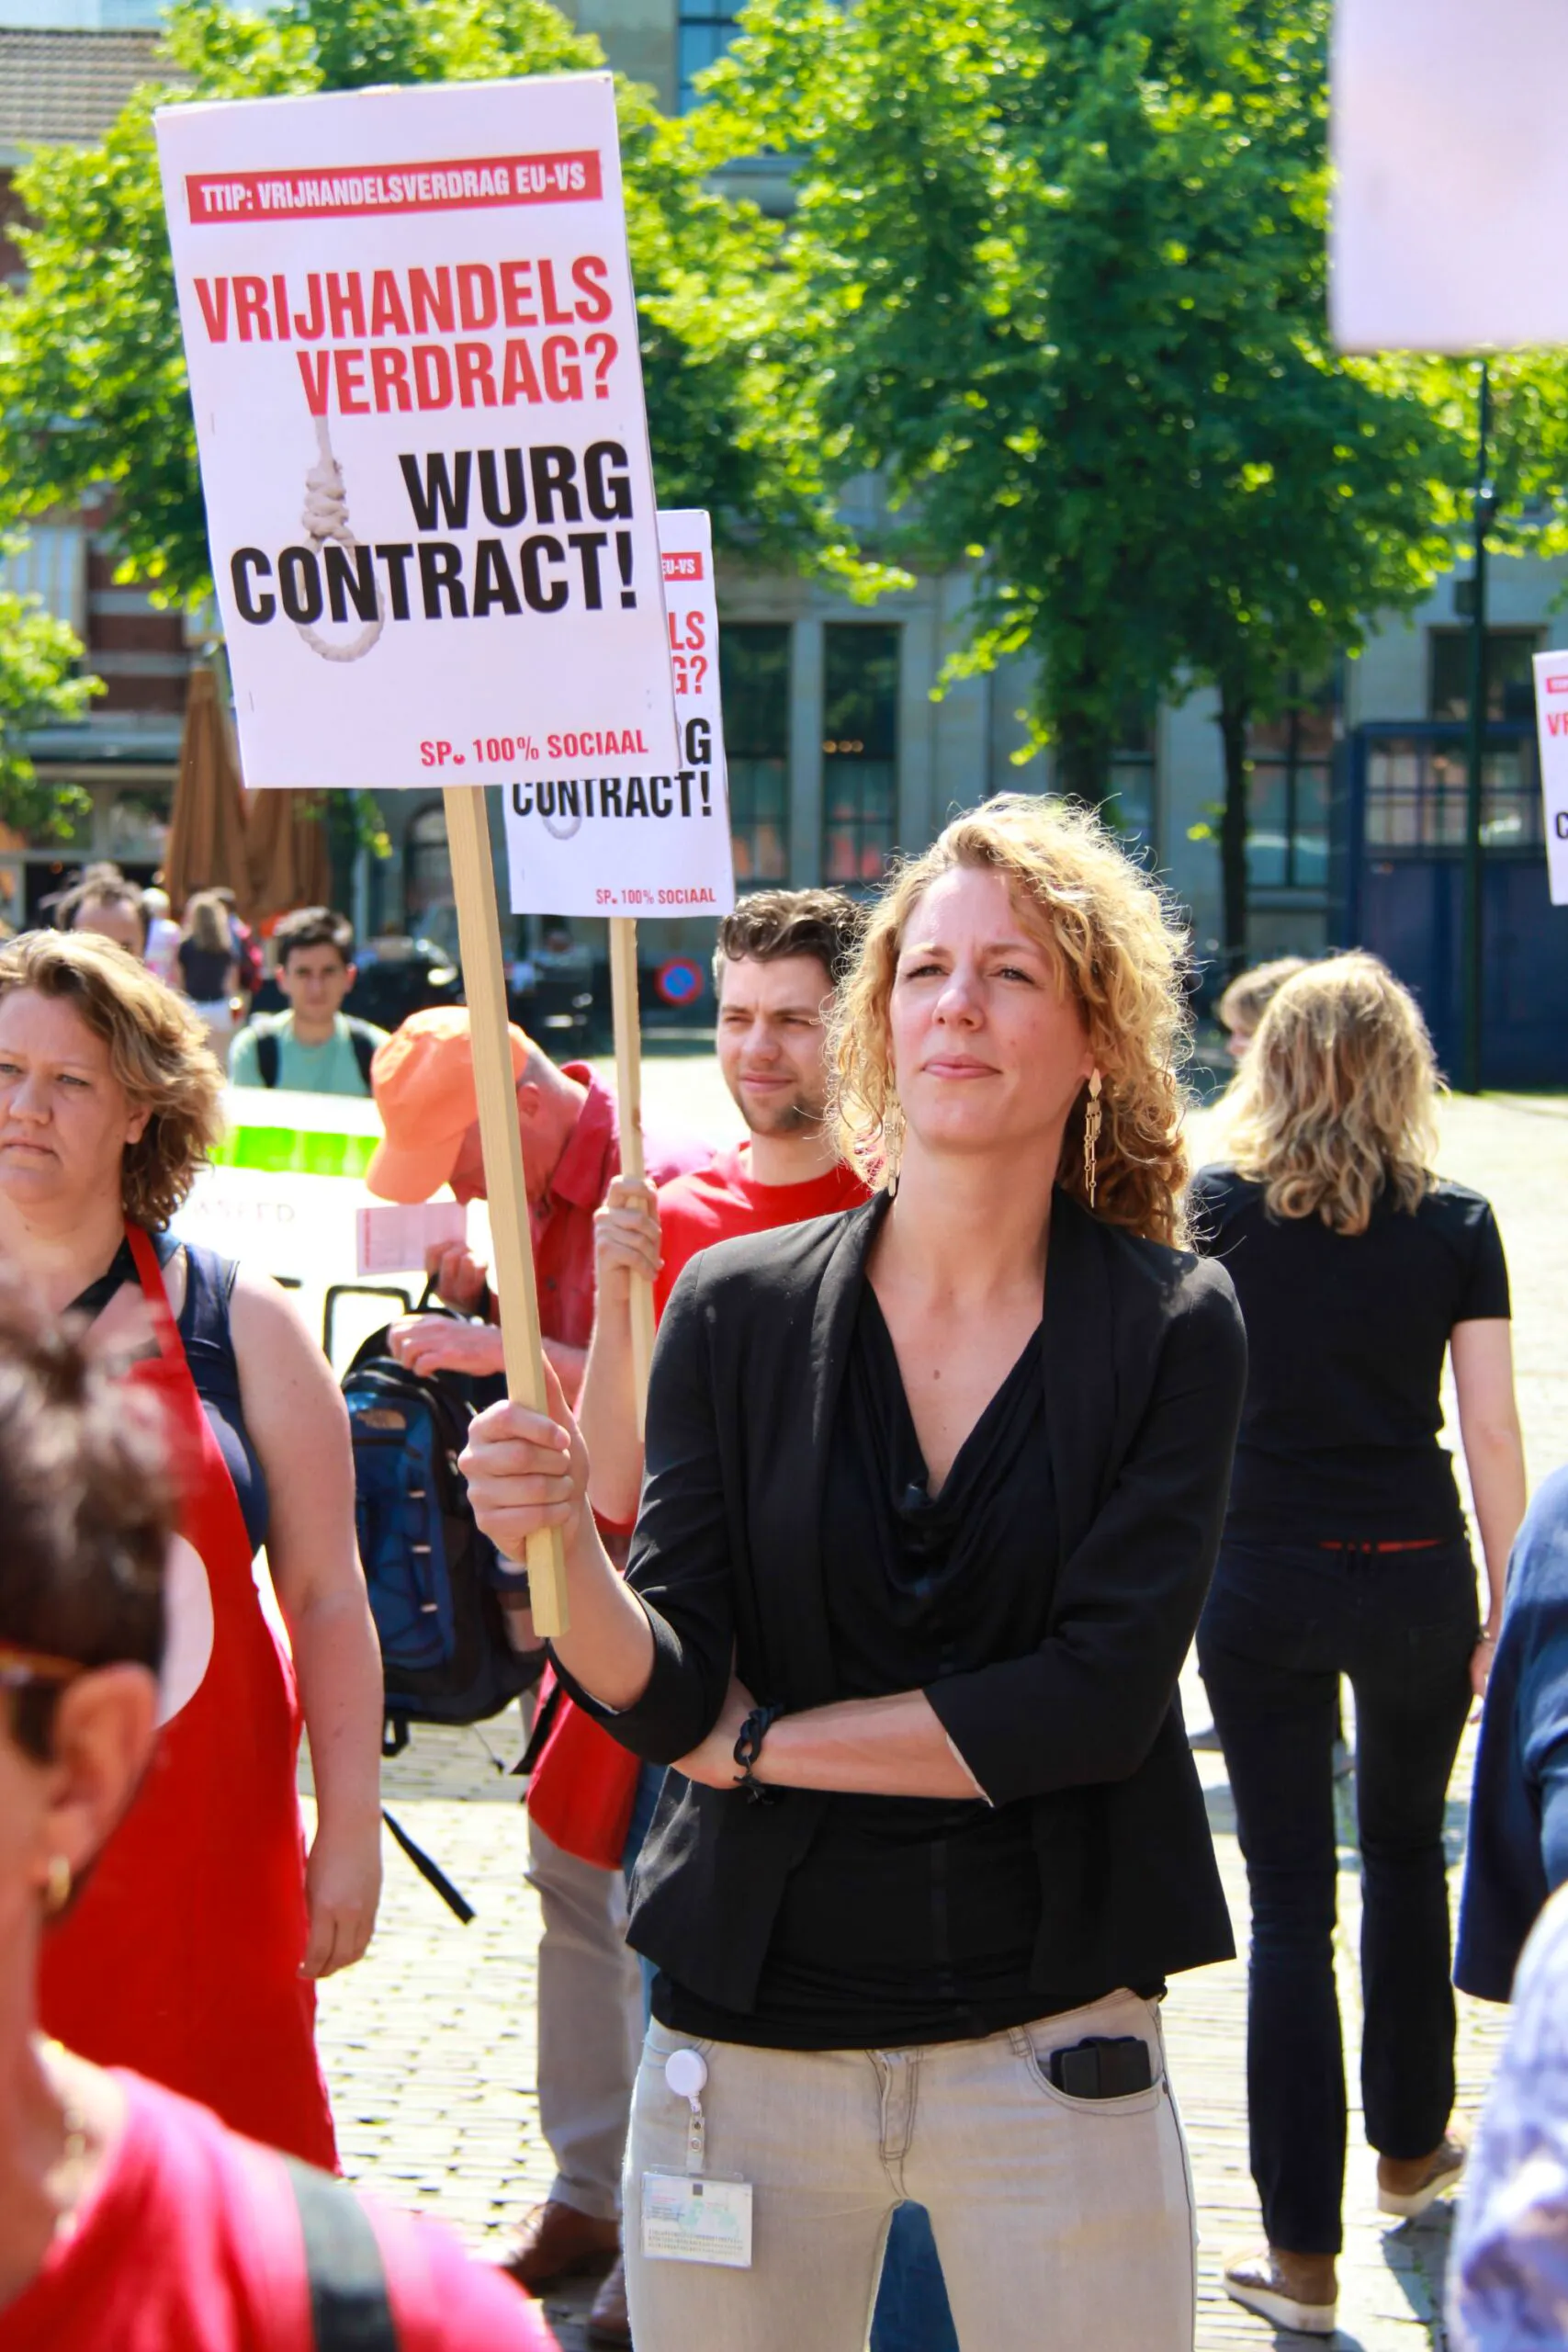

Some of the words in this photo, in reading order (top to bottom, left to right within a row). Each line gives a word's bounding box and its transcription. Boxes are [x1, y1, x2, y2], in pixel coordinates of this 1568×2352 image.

[199, 182, 254, 212] TTIP:
[257, 166, 511, 210] VRIJHANDELSVERDRAG
[515, 160, 587, 195] EU-VS
[194, 254, 613, 344] VRIJHANDELS
[296, 331, 618, 416] VERDRAG?
[399, 441, 633, 531] WURG
[230, 531, 637, 625] CONTRACT!
[473, 736, 540, 763] 100%
[547, 729, 649, 759] SOCIAAL
[512, 770, 712, 818] CONTRACT!
[621, 888, 654, 905] 100%
[658, 887, 716, 905] SOCIAAL
